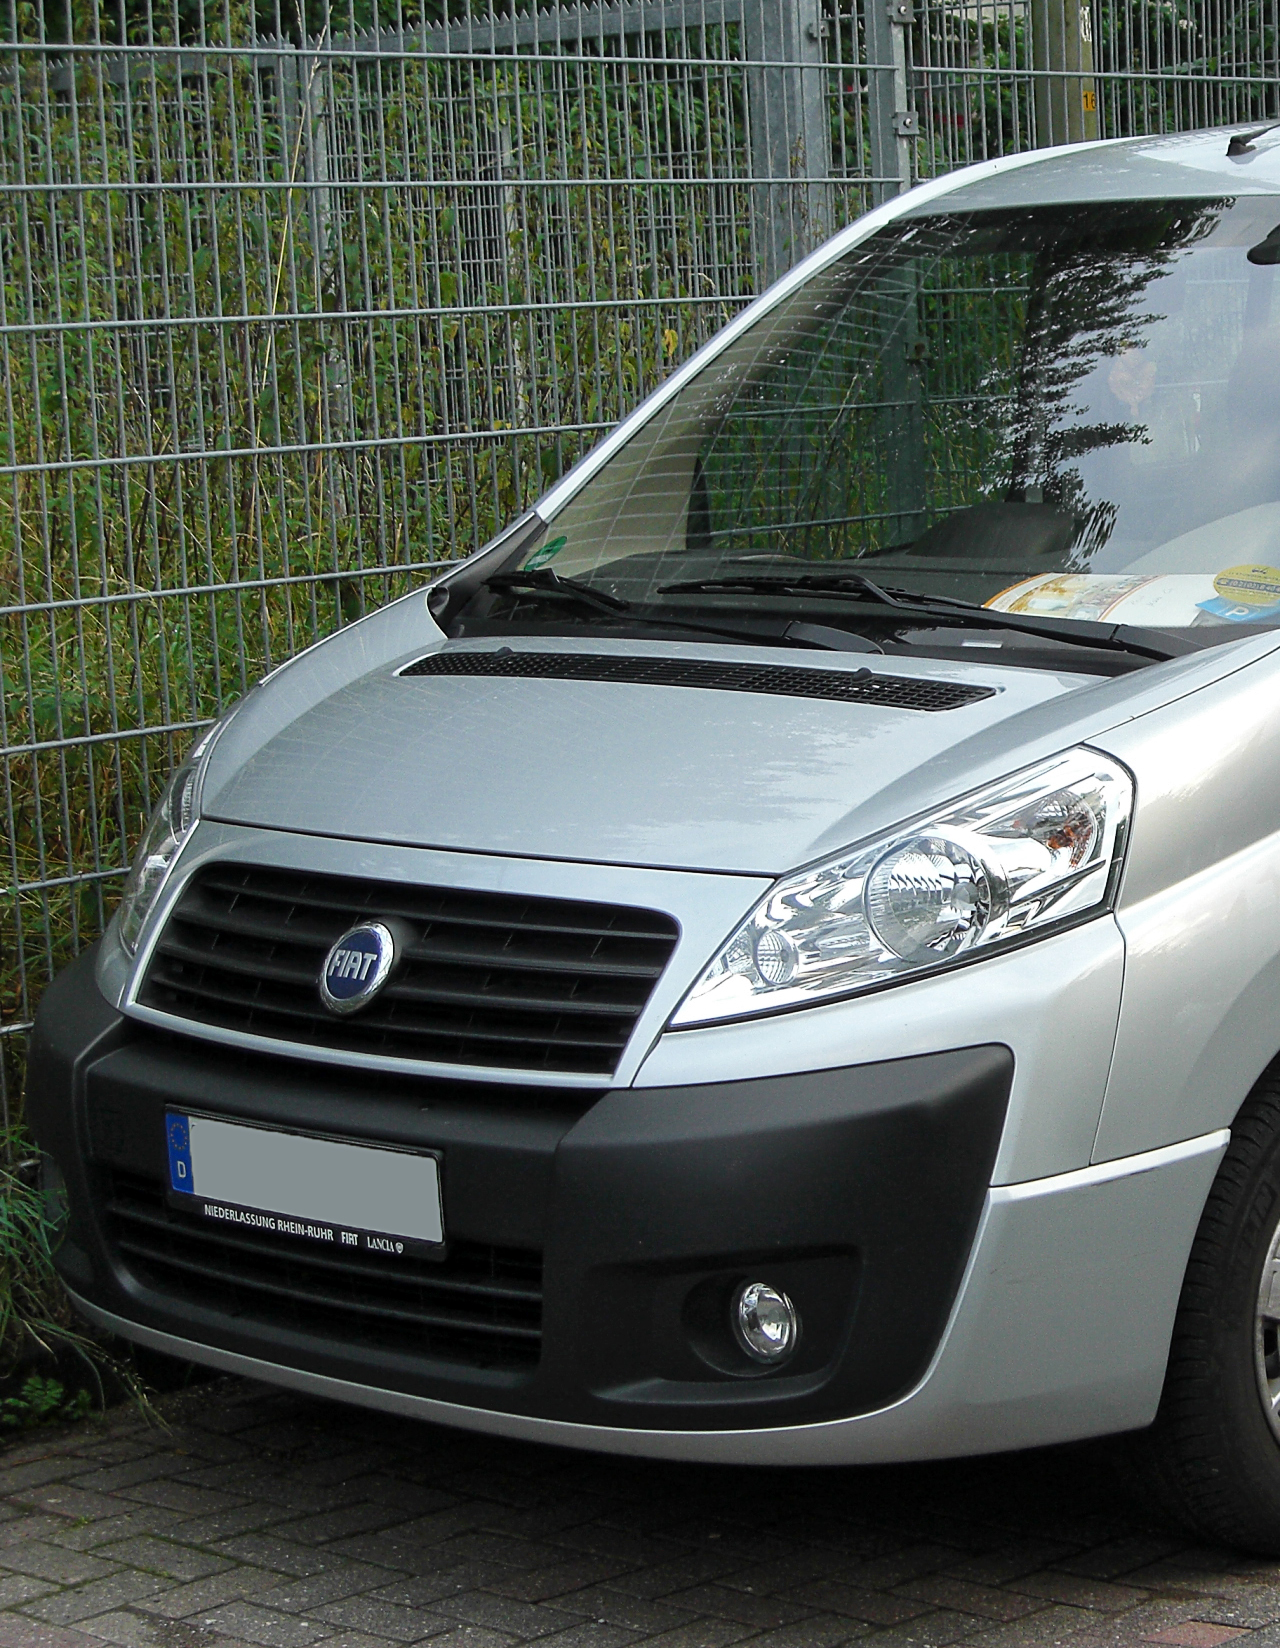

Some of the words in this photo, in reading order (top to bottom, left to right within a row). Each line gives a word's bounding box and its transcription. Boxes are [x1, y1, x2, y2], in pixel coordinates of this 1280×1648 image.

[328, 949, 378, 981] FIAT
[177, 1160, 187, 1178] D
[204, 1204, 276, 1230] NIEDERLASSUNG
[277, 1219, 334, 1241] RHEIN-RUHR
[341, 1231, 359, 1246] FIAT
[367, 1236, 395, 1253] LANCIA
